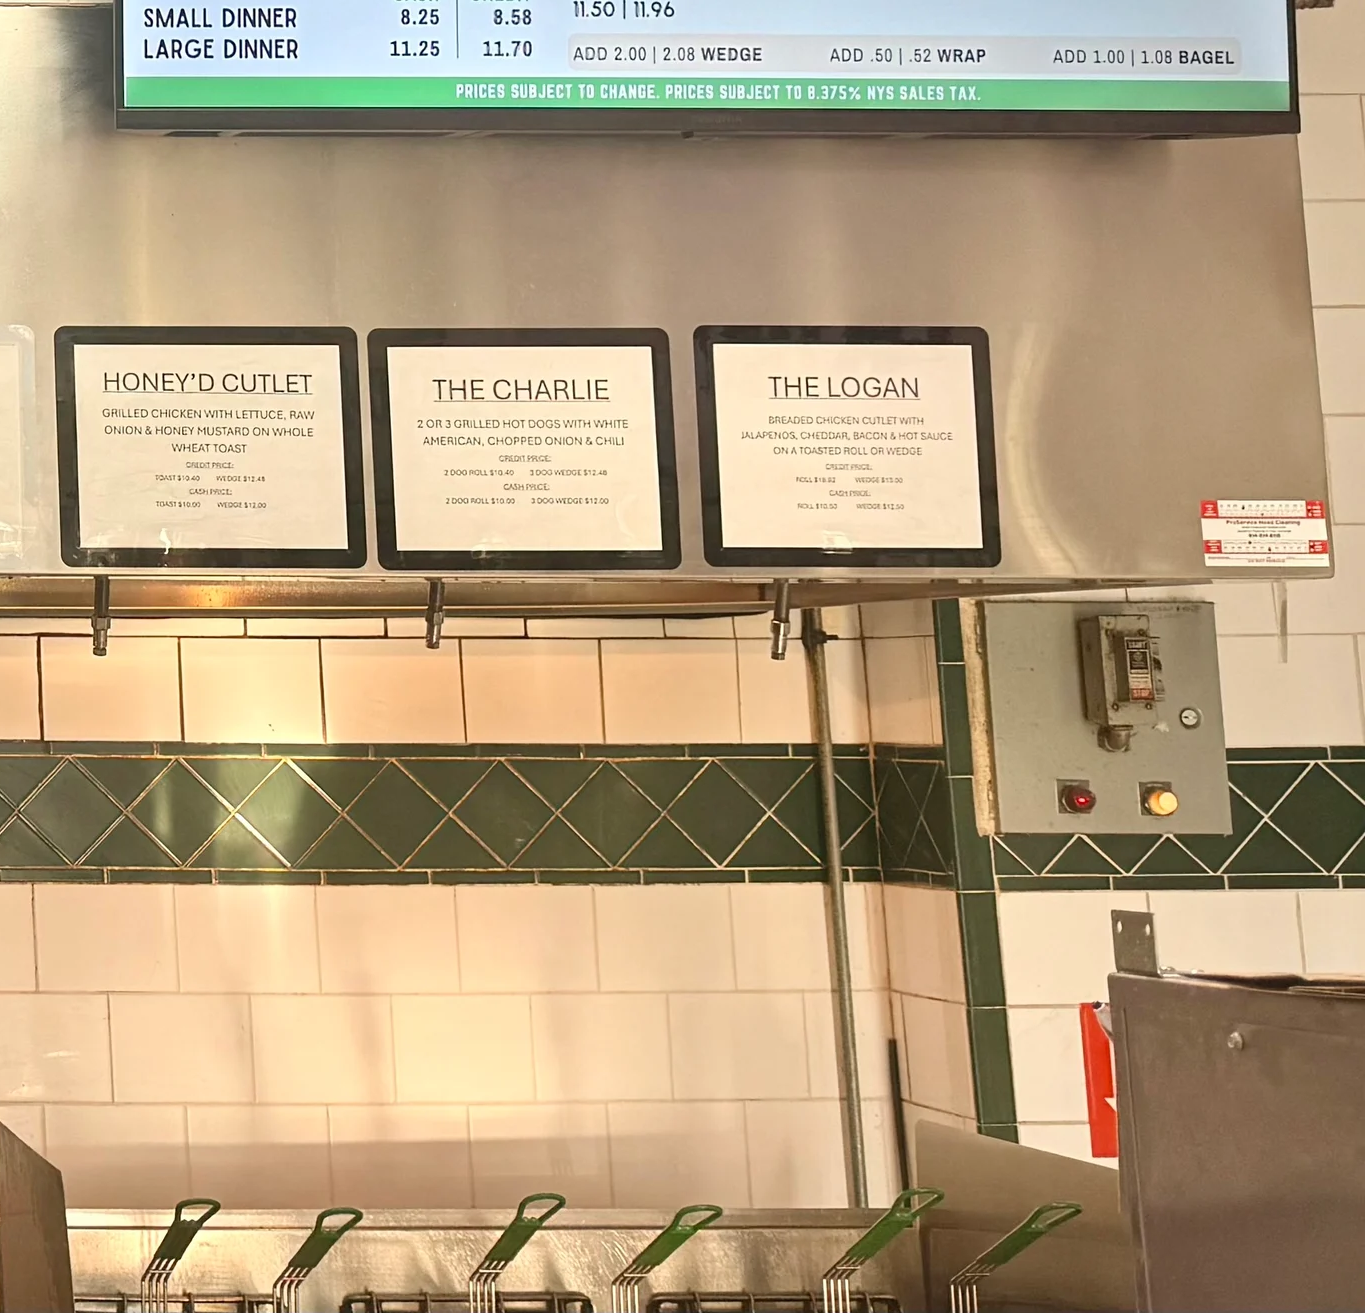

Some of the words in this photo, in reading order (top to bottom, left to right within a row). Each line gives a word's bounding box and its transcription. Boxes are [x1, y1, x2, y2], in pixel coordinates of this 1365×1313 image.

[937, 49, 986, 63] WRAP
[103, 372, 214, 393] HONEY'D
[222, 373, 312, 395] CUTLET
[432, 379, 485, 402] THE
[493, 379, 609, 402] CHARLIE
[768, 376, 819, 399] THE
[828, 377, 920, 399] LOGAN
